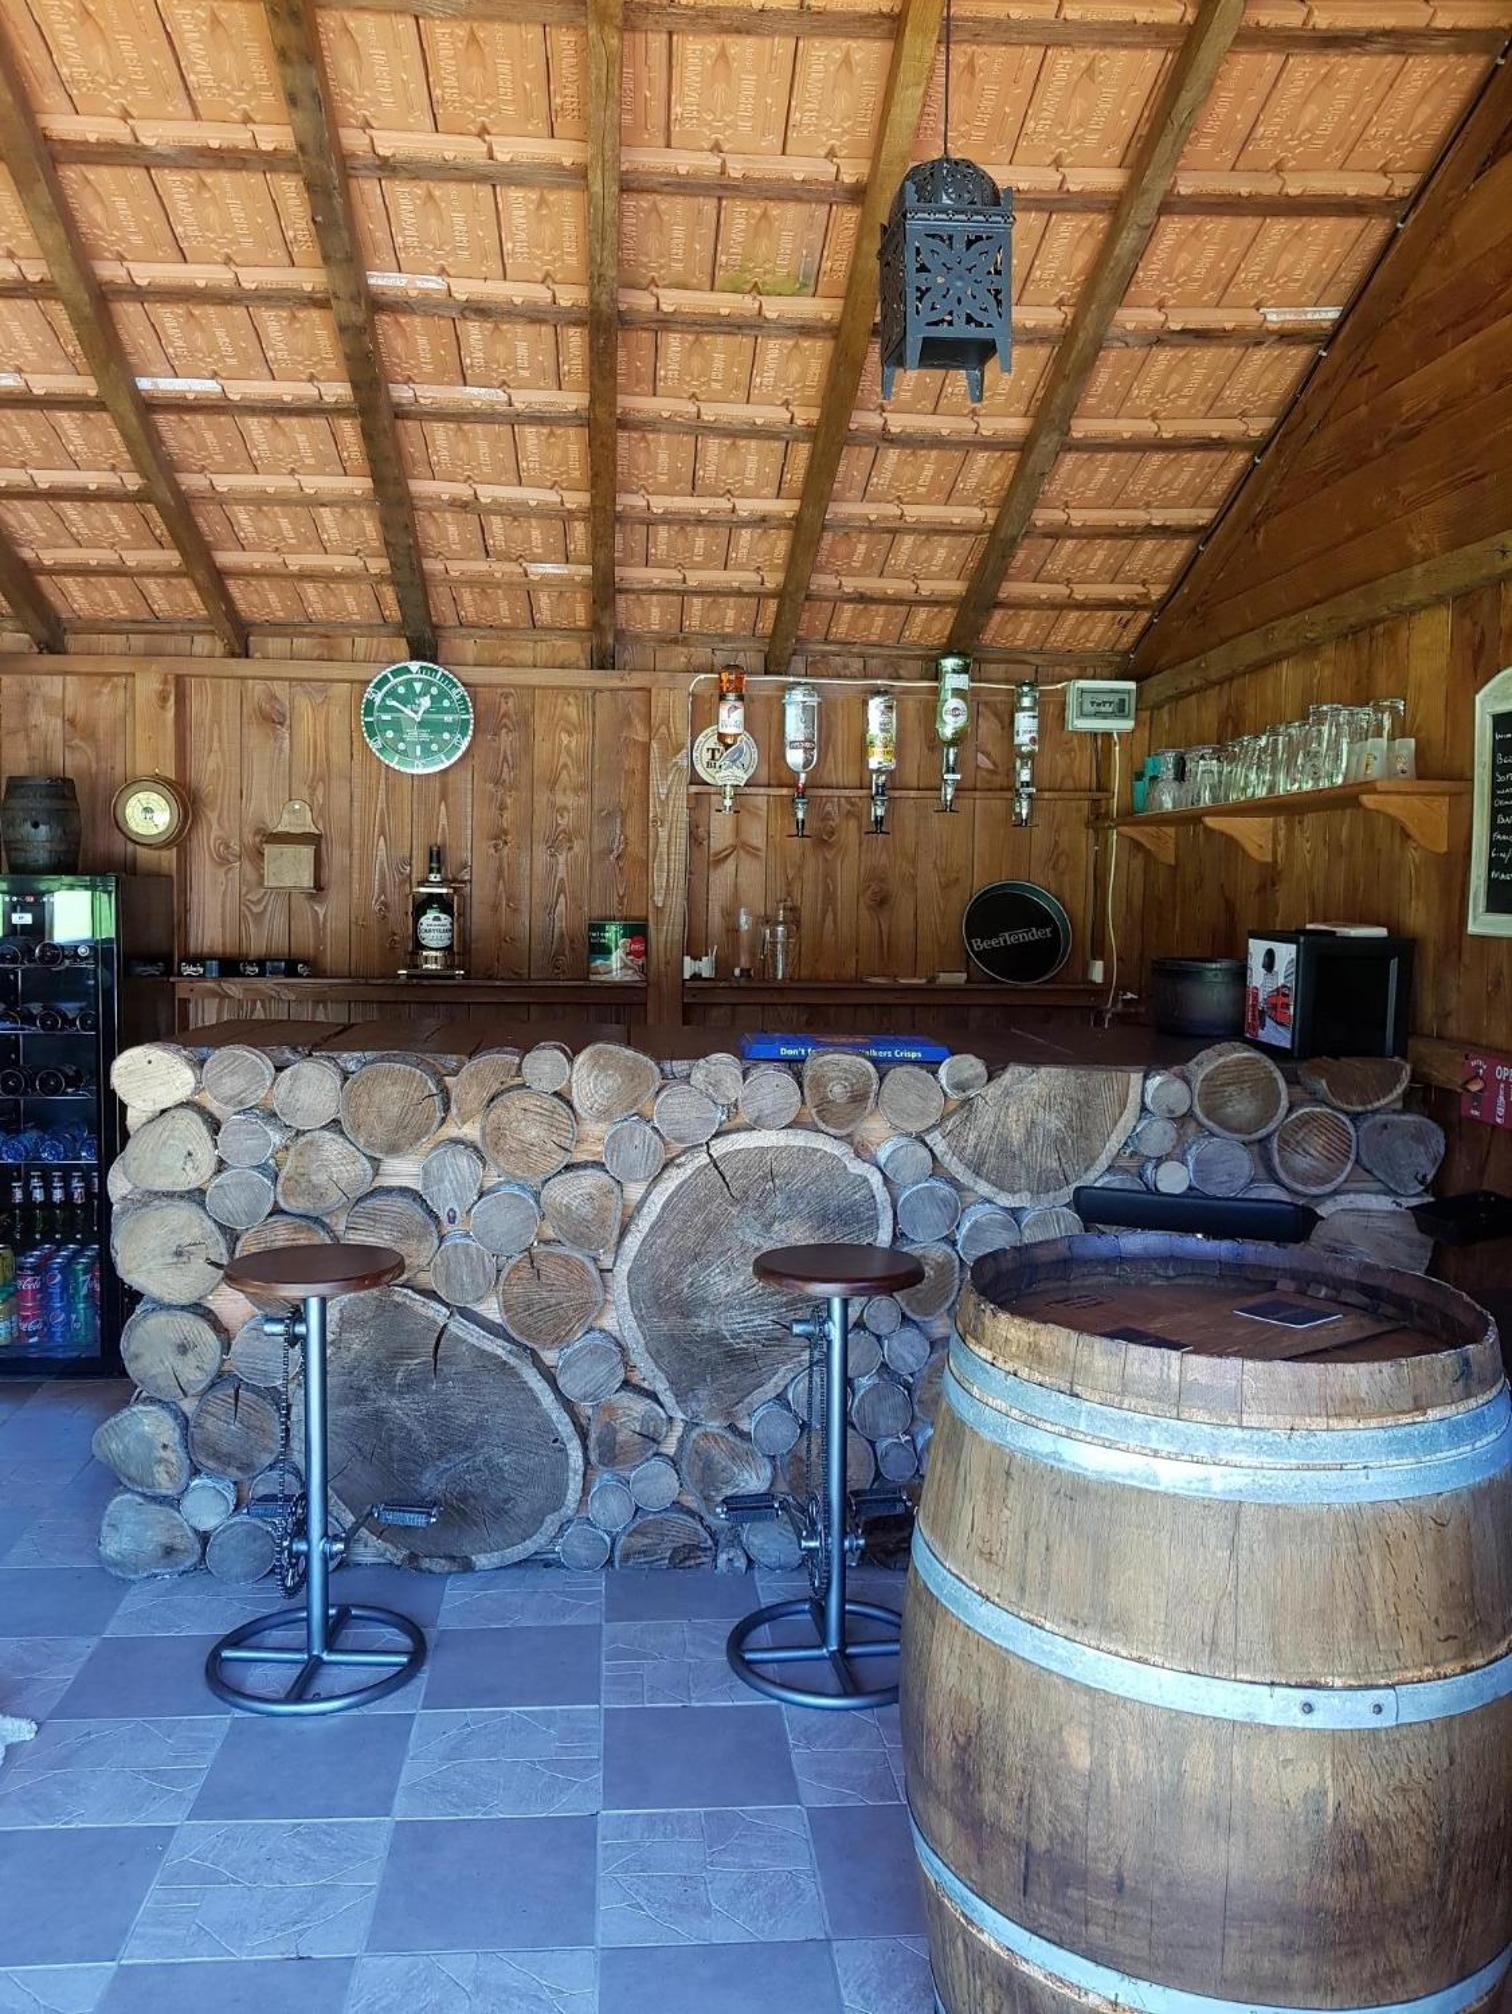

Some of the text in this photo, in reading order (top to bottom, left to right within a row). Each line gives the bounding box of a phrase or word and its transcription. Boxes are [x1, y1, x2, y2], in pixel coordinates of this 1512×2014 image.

[971, 926, 1053, 952] BeerTender
[780, 1047, 806, 1057] Don't
[859, 1048, 892, 1058] alkers
[894, 1049, 922, 1060] Crisps
